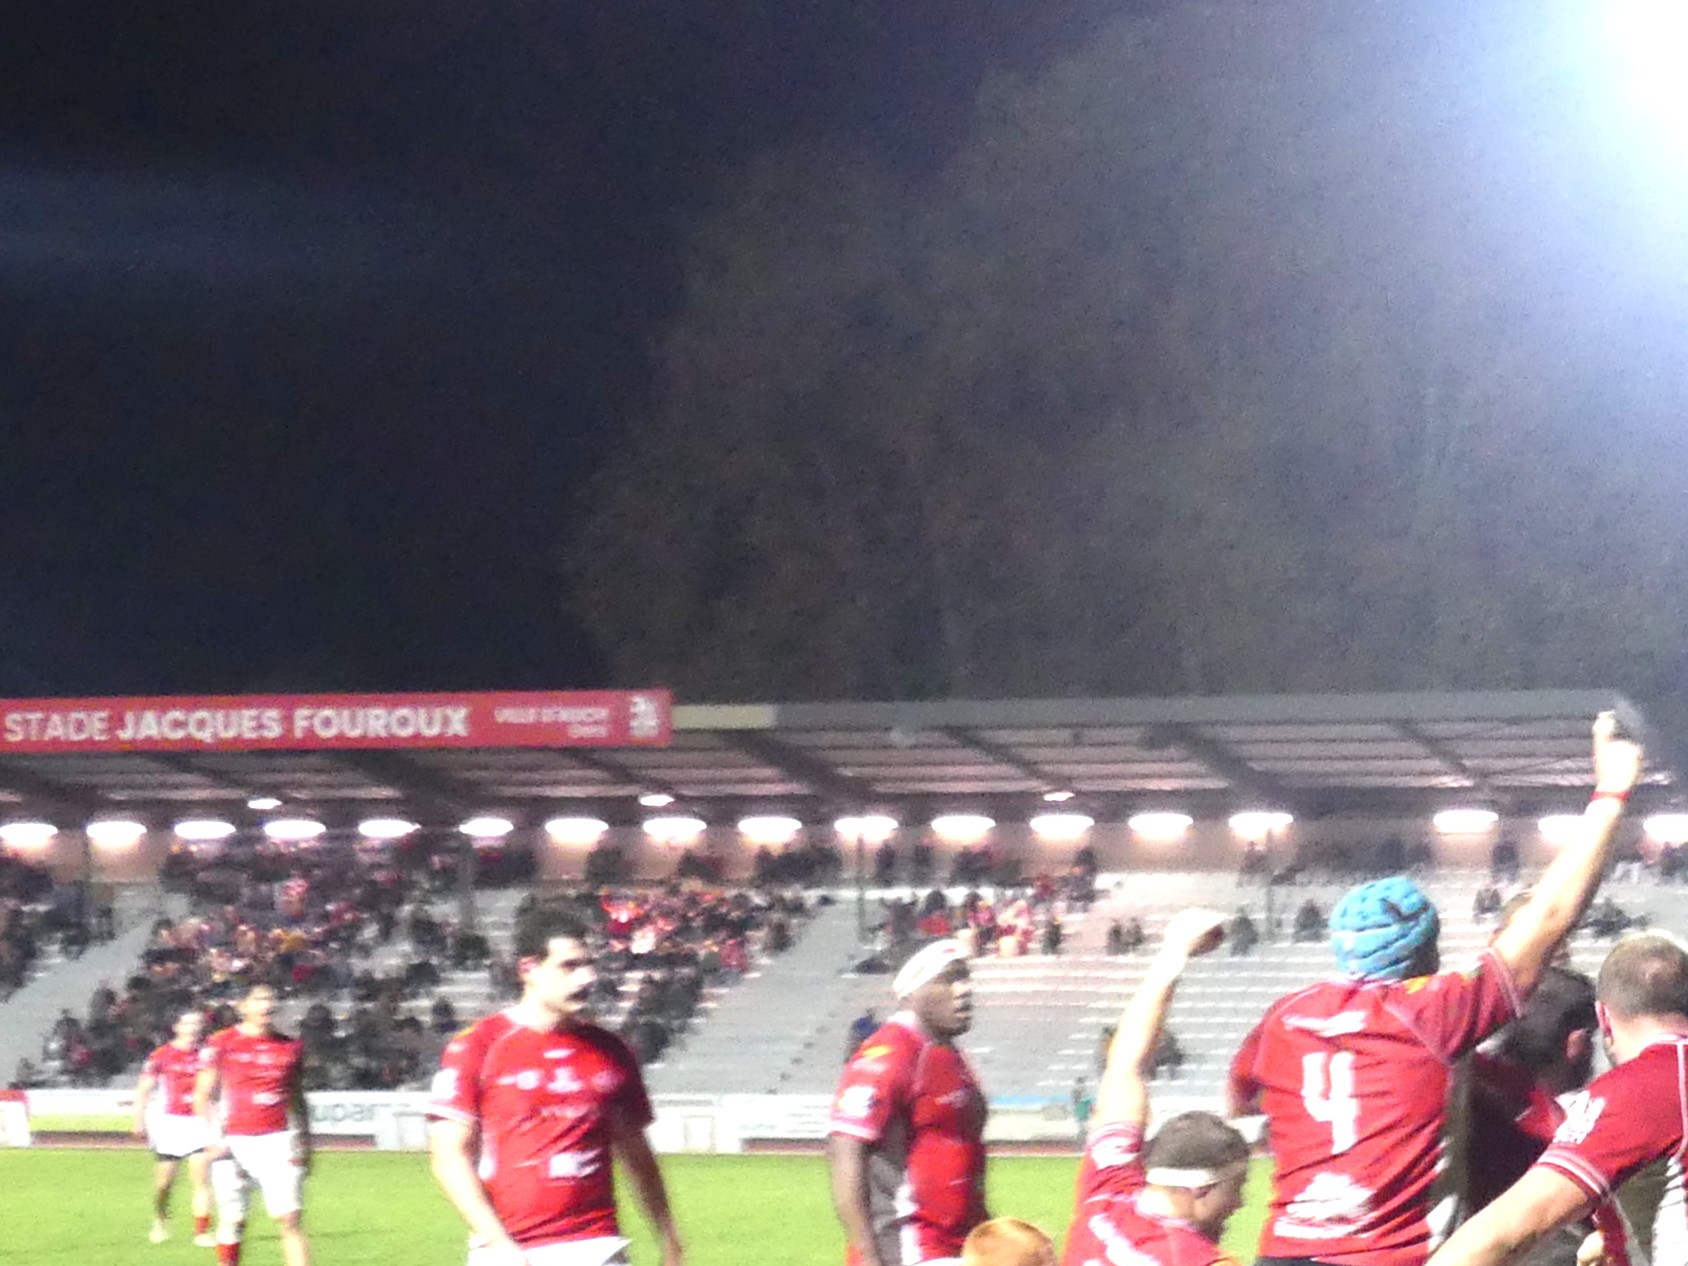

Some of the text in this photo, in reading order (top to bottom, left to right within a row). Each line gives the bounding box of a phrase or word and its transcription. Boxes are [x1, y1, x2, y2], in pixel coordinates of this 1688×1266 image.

[4, 710, 110, 742] STADE
[115, 707, 284, 743] JACQUES
[293, 705, 470, 739] FOUROUX
[1300, 1050, 1358, 1155] 4
